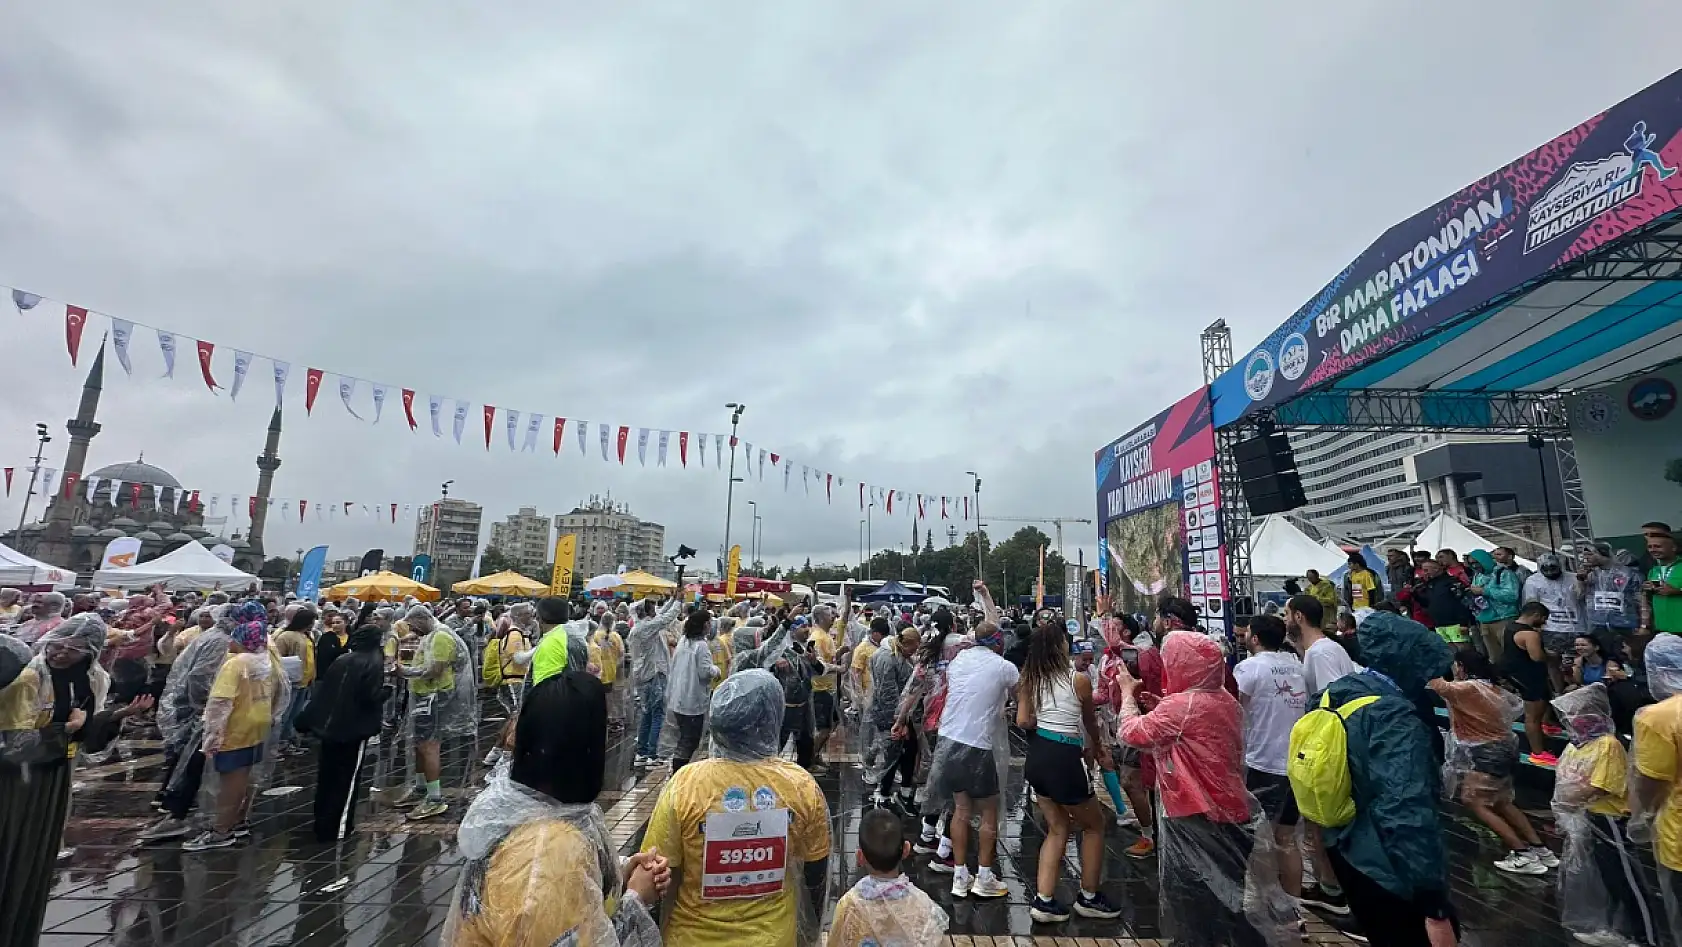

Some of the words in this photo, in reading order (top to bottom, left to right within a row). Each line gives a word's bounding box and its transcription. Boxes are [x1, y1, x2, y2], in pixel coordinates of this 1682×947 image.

[1344, 189, 1504, 320] MARATONDAN
[1340, 307, 1390, 355] DAHA
[1390, 249, 1479, 324] FAZLASI
[1124, 468, 1172, 513] MARATONU
[719, 847, 773, 864] 39301
